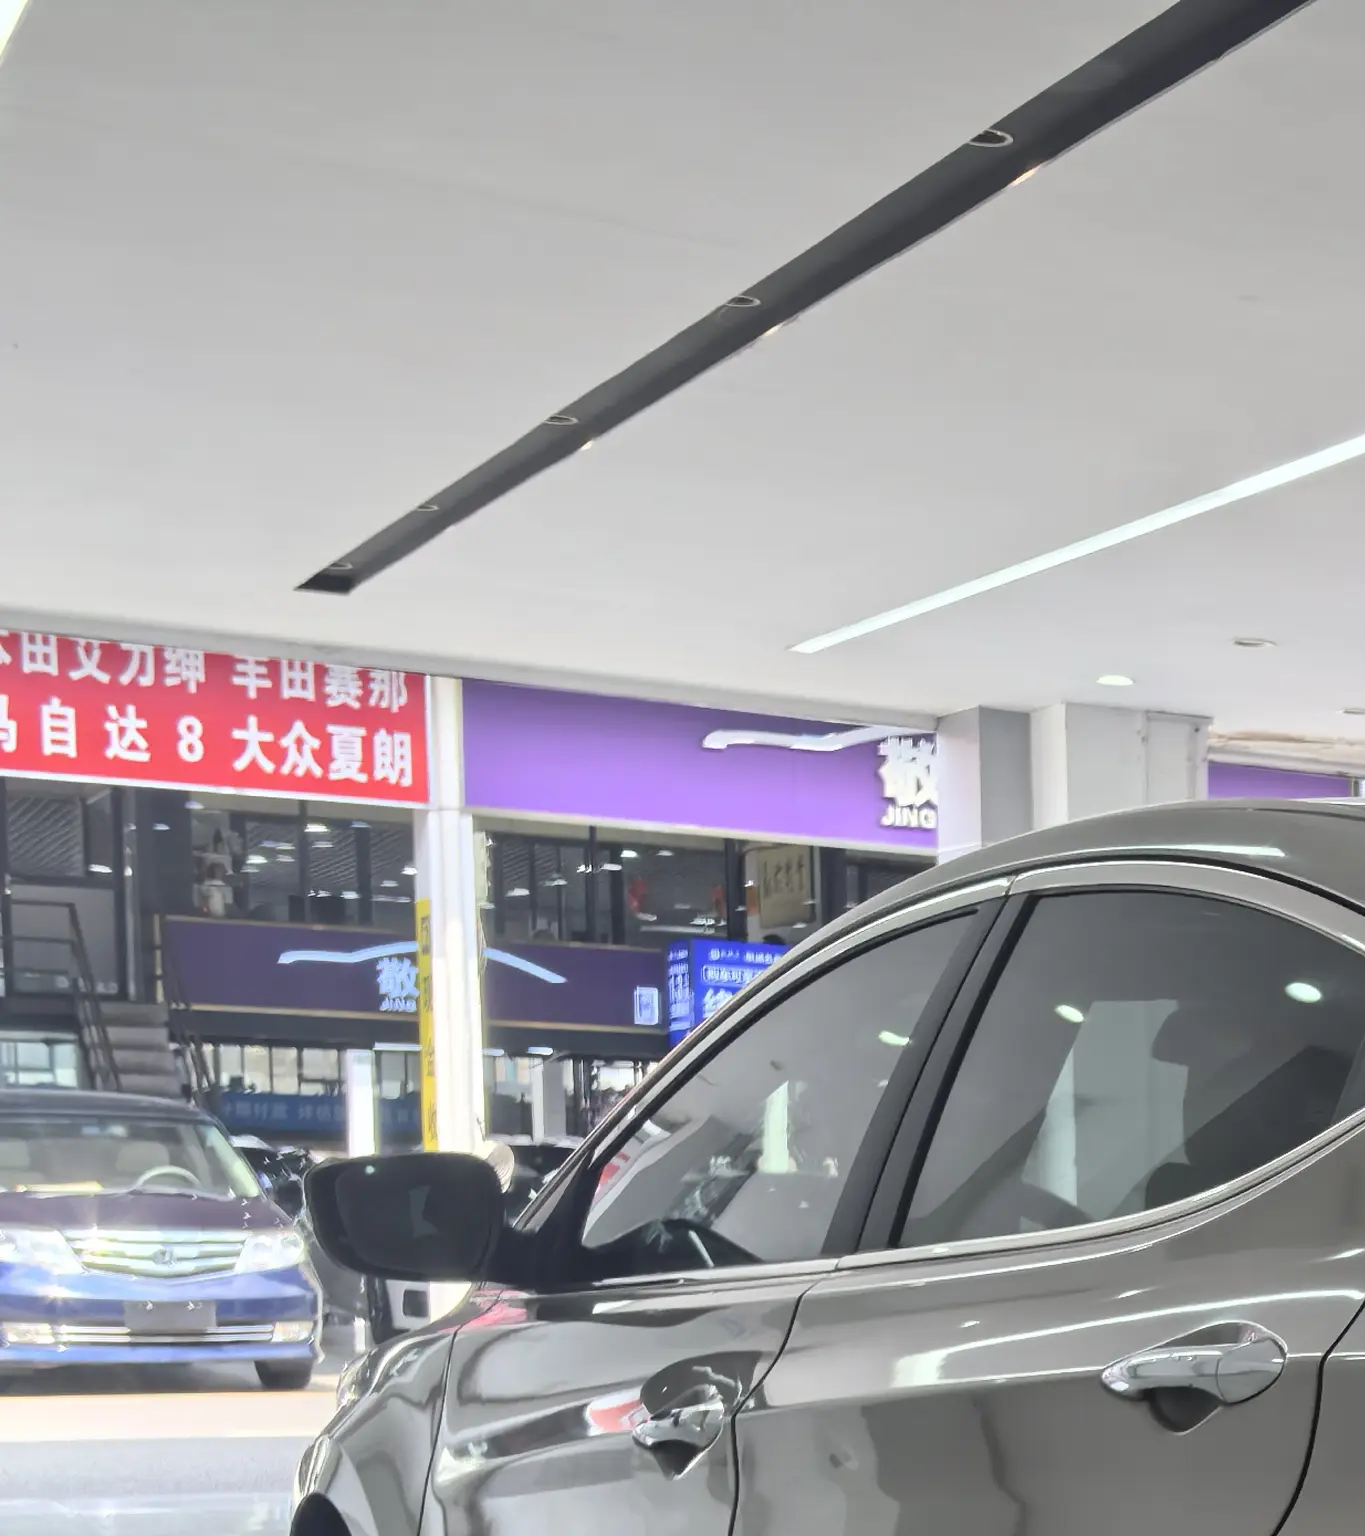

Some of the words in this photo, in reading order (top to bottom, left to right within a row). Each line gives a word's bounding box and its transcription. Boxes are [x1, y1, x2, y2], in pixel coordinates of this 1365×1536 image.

[231, 654, 408, 714] 丰田赛那
[176, 714, 206, 763] 8
[231, 713, 413, 788] 大众夏朗
